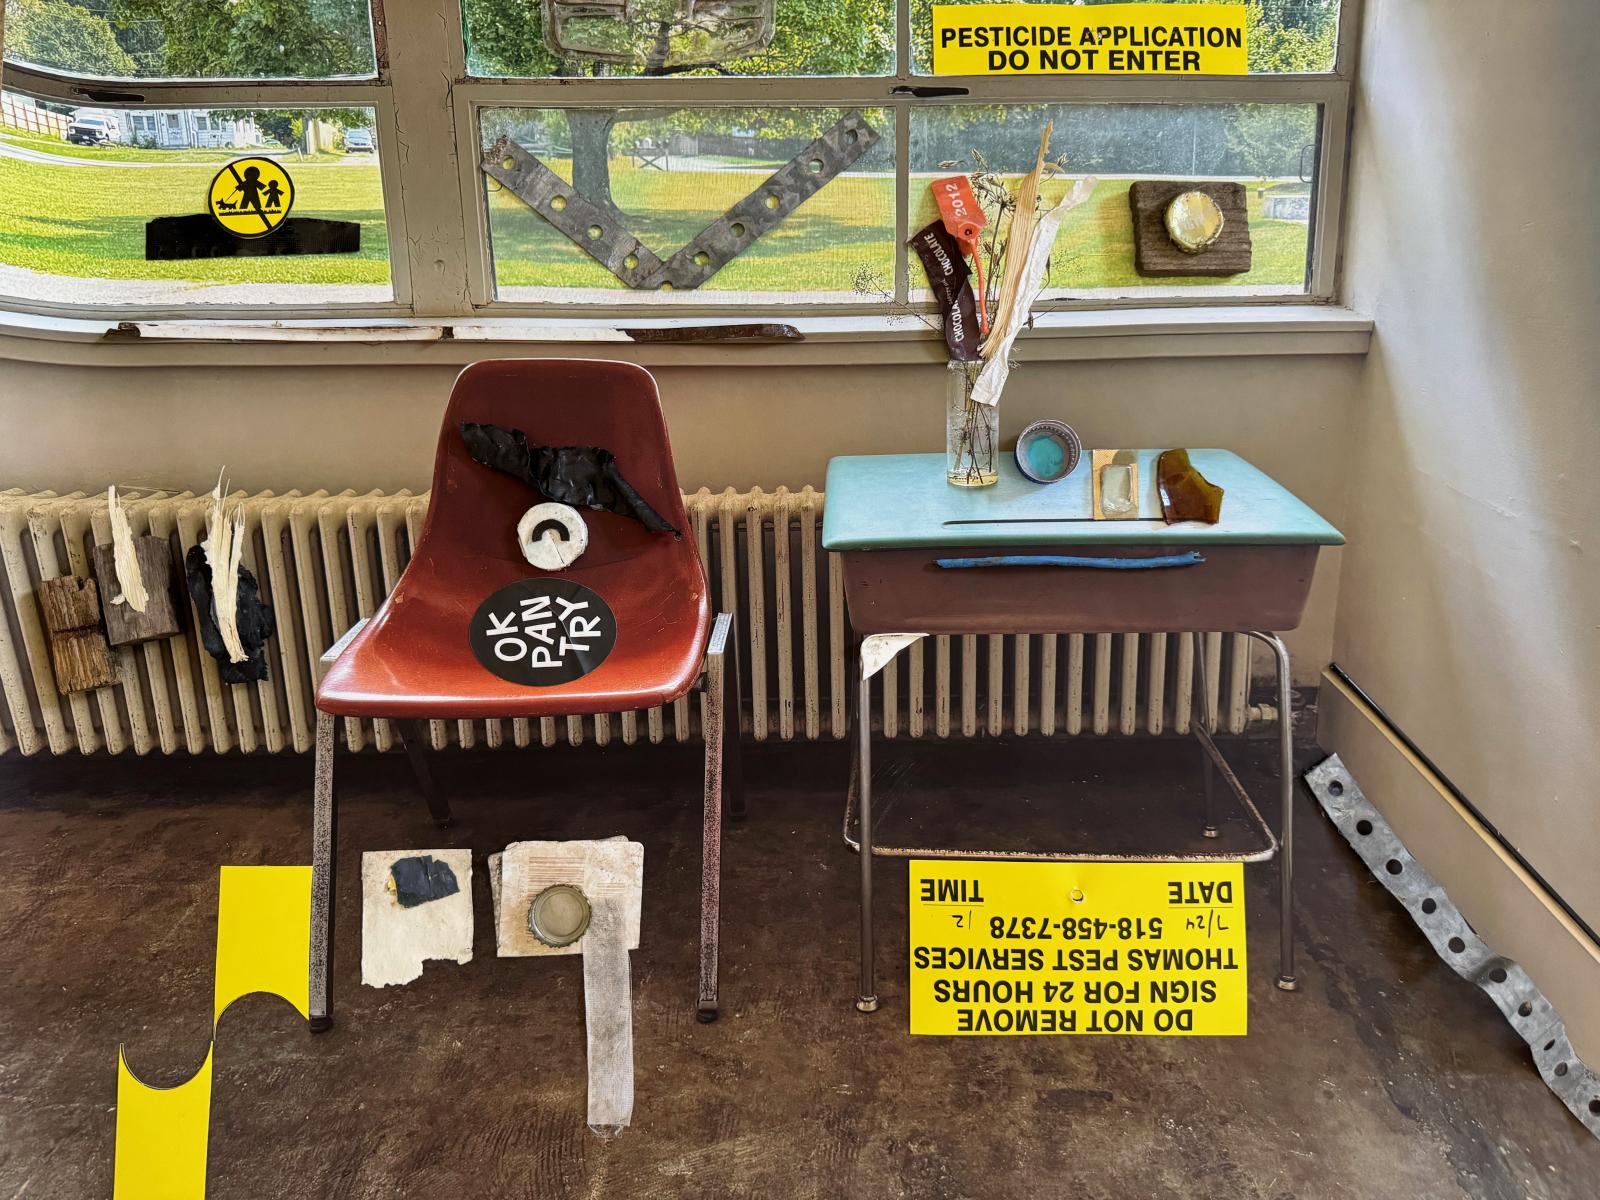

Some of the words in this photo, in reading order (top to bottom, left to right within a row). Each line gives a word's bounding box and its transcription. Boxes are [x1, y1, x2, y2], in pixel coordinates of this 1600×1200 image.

[942, 26, 1071, 48] PESTICIDE
[1079, 26, 1241, 47] APPLICATION
[989, 50, 1029, 70] DO
[1040, 49, 1098, 70] NOT
[1109, 50, 1200, 71] ENTER
[944, 183, 967, 217] 2012
[923, 232, 954, 276] CHOCOLATE
[486, 611, 527, 662] OK
[520, 596, 563, 668] PAN
[555, 597, 601, 656] TRY
[920, 879, 984, 902] TIME
[1168, 882, 1232, 904] DATE
[990, 917, 1162, 940] 518-458-7378
[914, 947, 1044, 971] SERVICES
[1053, 949, 1118, 971] PEST
[1128, 948, 1238, 971] THOMAS
[934, 980, 1032, 1003] HOURS
[1043, 982, 1074, 1003] 24
[1085, 981, 1139, 1004] FOR
[1151, 980, 1216, 1003] SIGN
[958, 1009, 1076, 1032] REMOVE
[1086, 1010, 1143, 1032] NOT
[1154, 1009, 1192, 1031] DO
